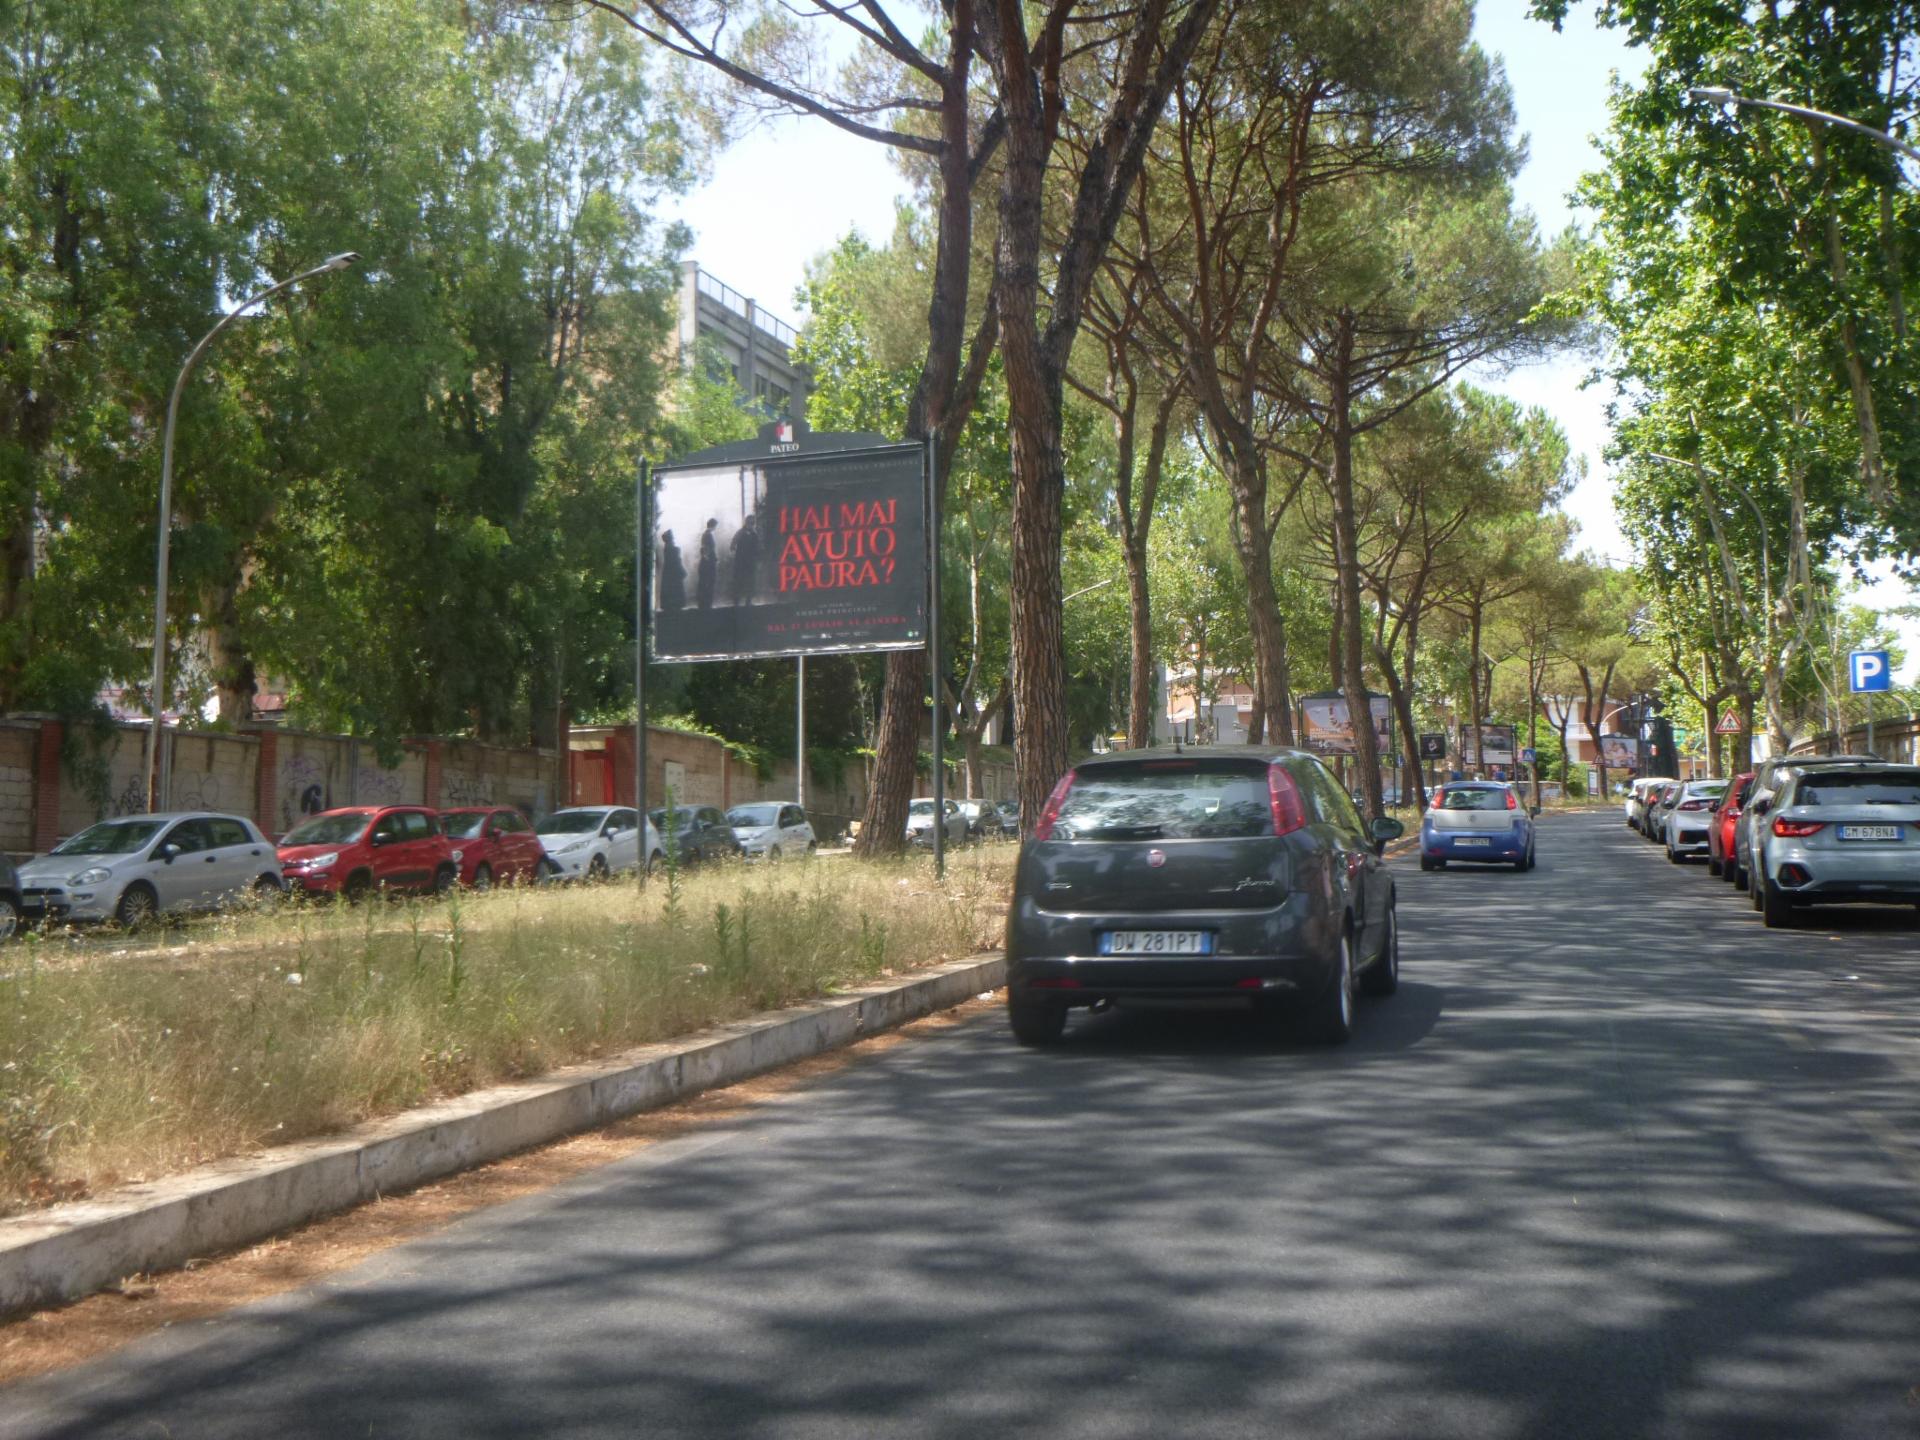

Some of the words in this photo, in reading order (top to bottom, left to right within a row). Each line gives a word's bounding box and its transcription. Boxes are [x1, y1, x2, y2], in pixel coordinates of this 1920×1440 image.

[770, 442, 800, 454] PATEO
[778, 503, 832, 534] HAI
[839, 498, 897, 529] MAI
[778, 527, 896, 565] AVUTO
[778, 557, 896, 593] PAURA?
[1855, 654, 1882, 688] P
[1113, 932, 1138, 952] DW
[1143, 931, 1200, 952] 281PT
